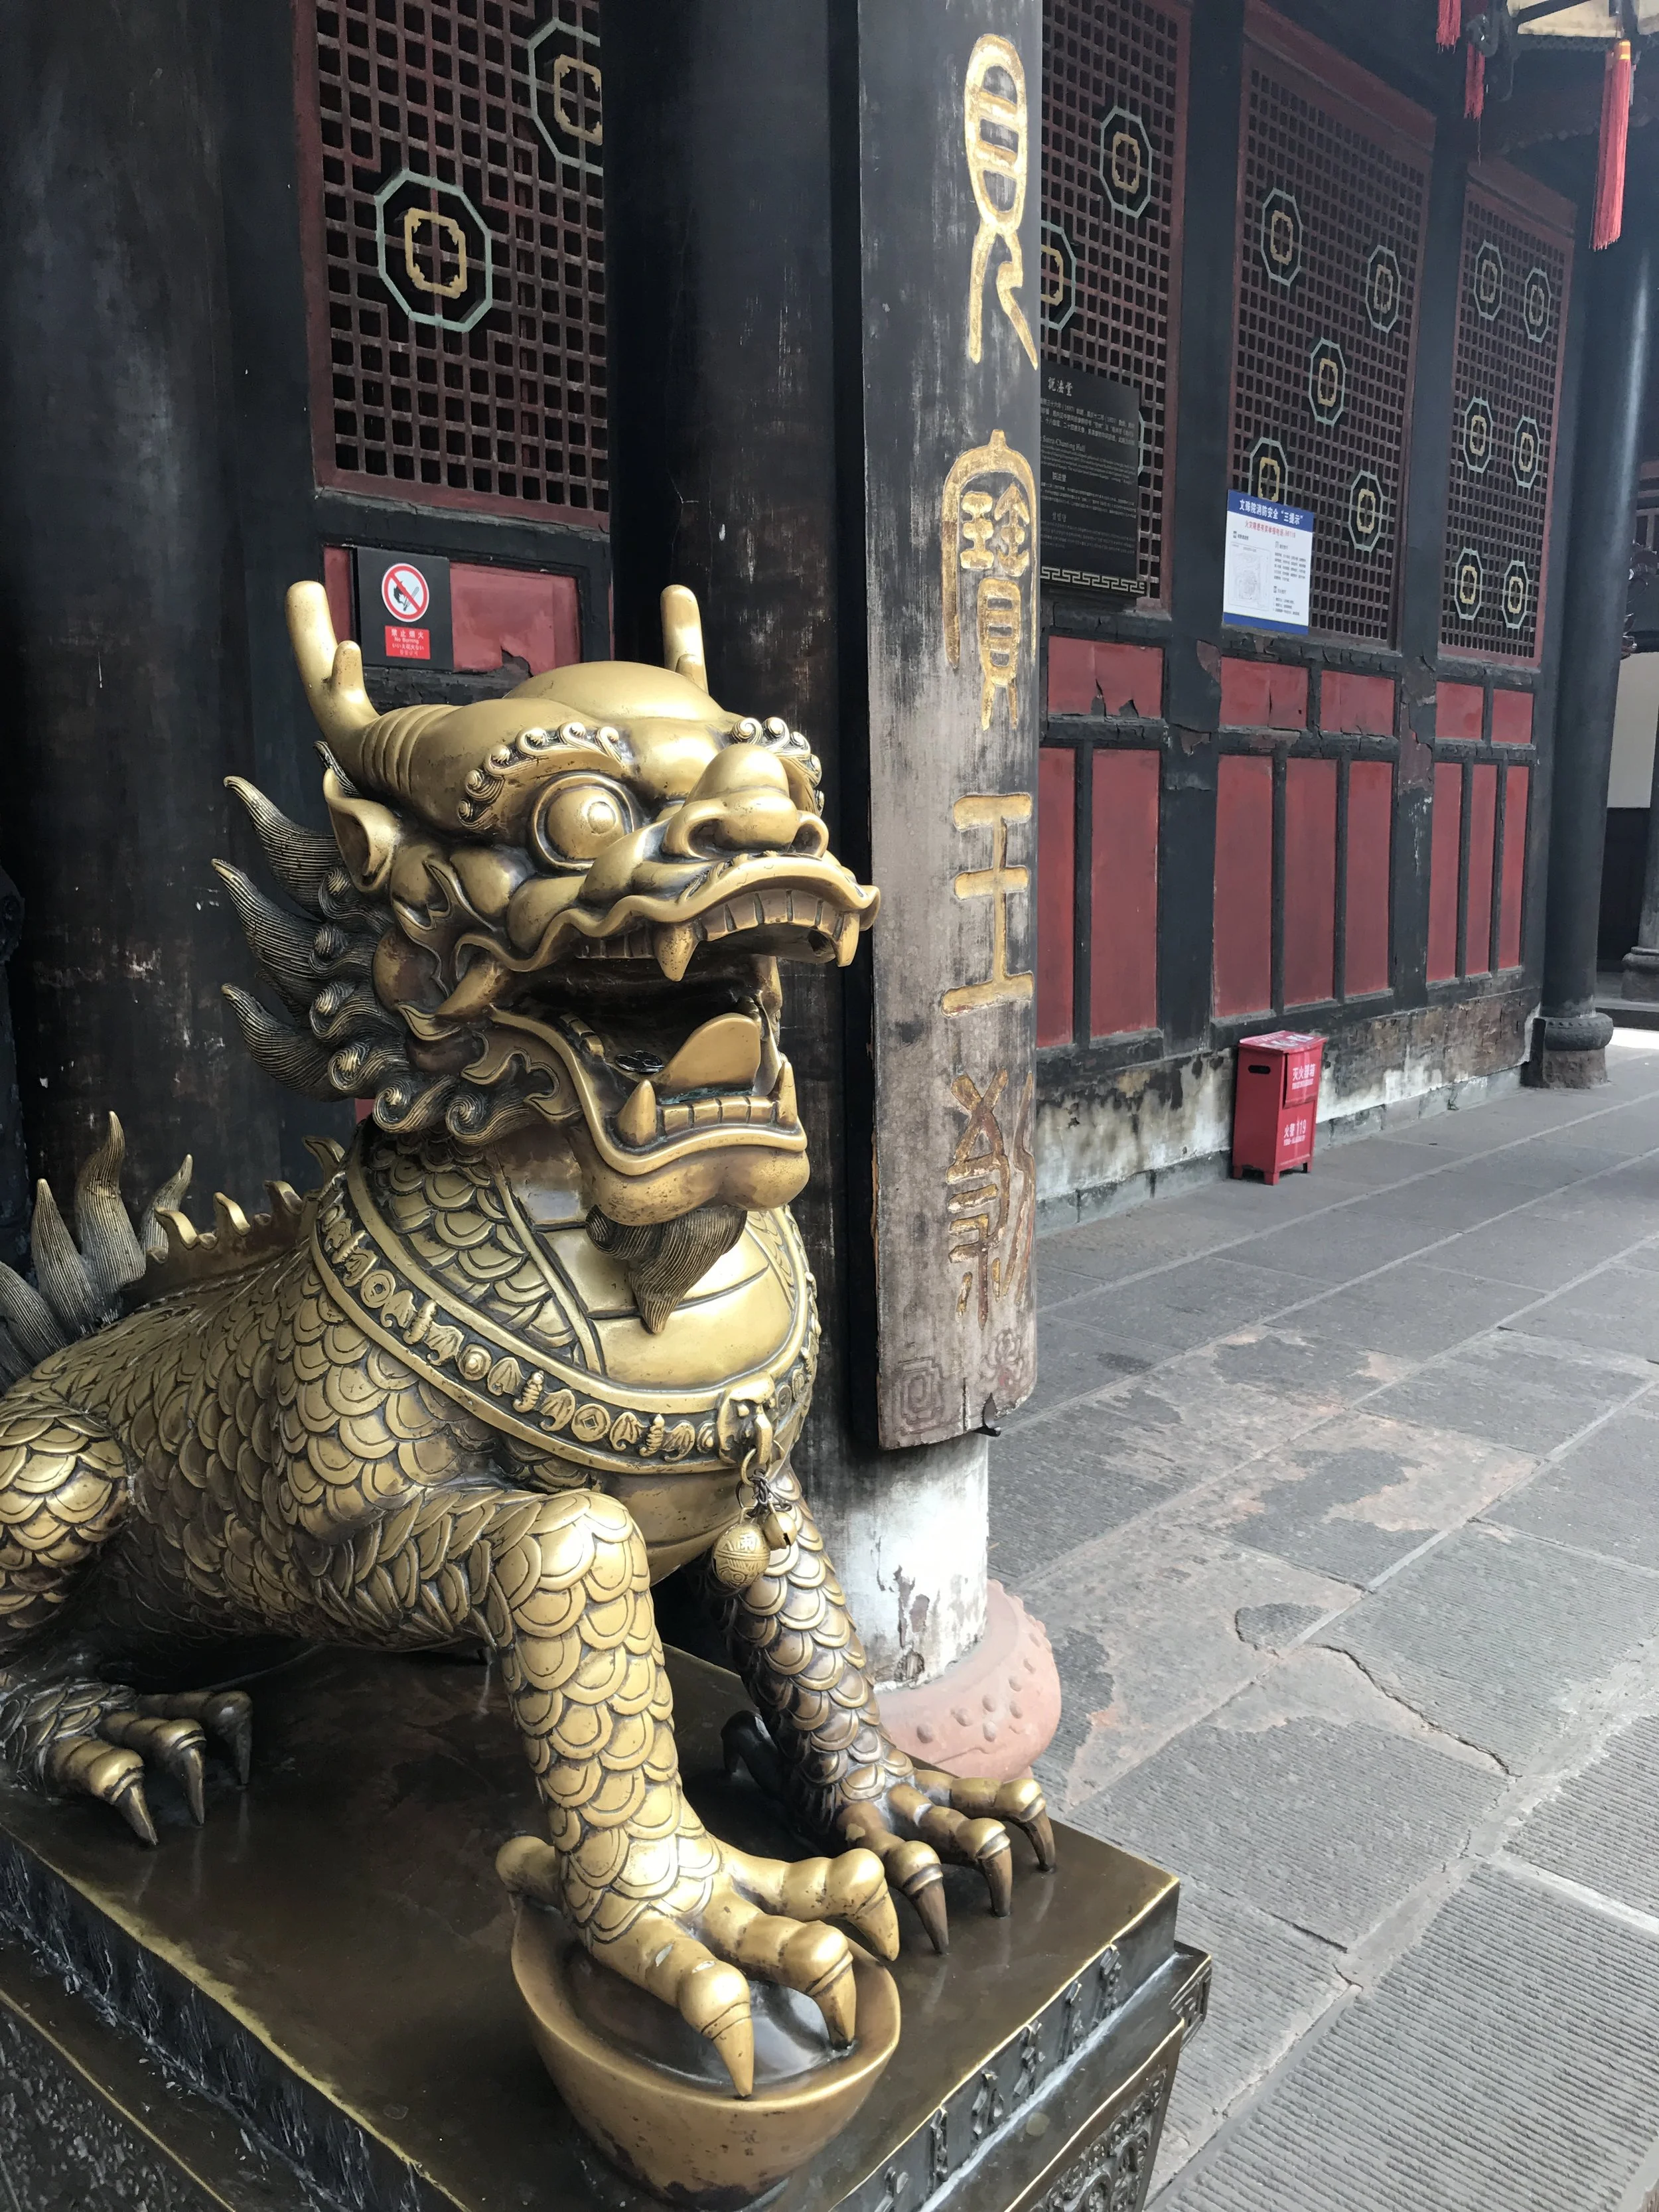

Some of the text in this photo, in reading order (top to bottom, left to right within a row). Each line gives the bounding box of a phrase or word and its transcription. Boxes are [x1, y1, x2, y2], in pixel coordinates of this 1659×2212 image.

[1292, 1063, 1316, 1082] 灭火器箱
[1283, 1118, 1307, 1139] 火警 119
